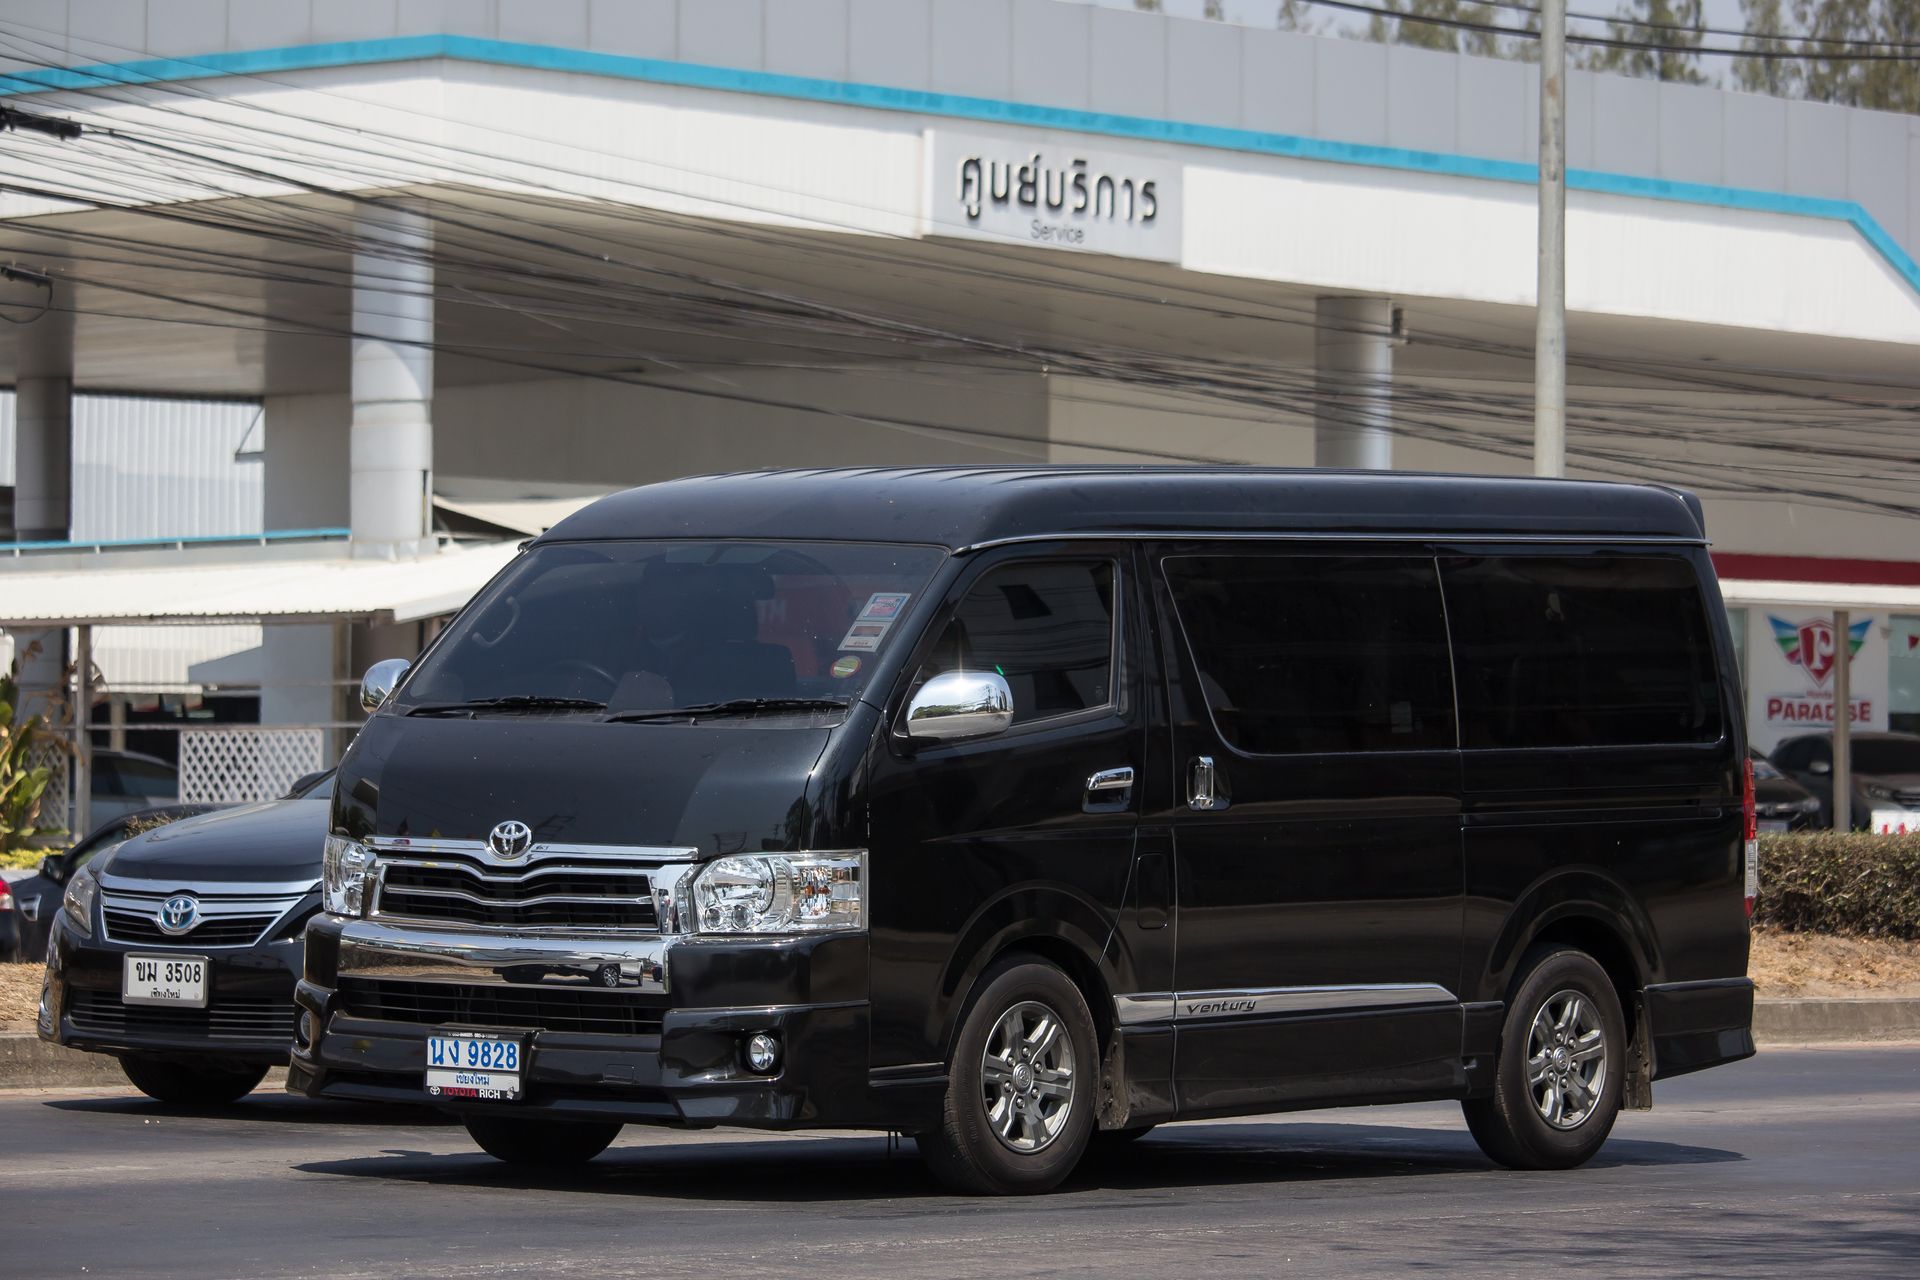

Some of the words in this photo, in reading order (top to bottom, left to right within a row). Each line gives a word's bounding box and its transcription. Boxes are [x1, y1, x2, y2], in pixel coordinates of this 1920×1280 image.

[961, 154, 1157, 222] ศูนย์บริการ
[1031, 220, 1084, 243] Service
[1767, 698, 1871, 722] PARADSE
[165, 963, 201, 983] 3508
[468, 1040, 517, 1069] 9828
[456, 1070, 490, 1086] เชียงใหม่
[443, 1087, 477, 1097] TOYOTA
[479, 1089, 501, 1099] RICH
